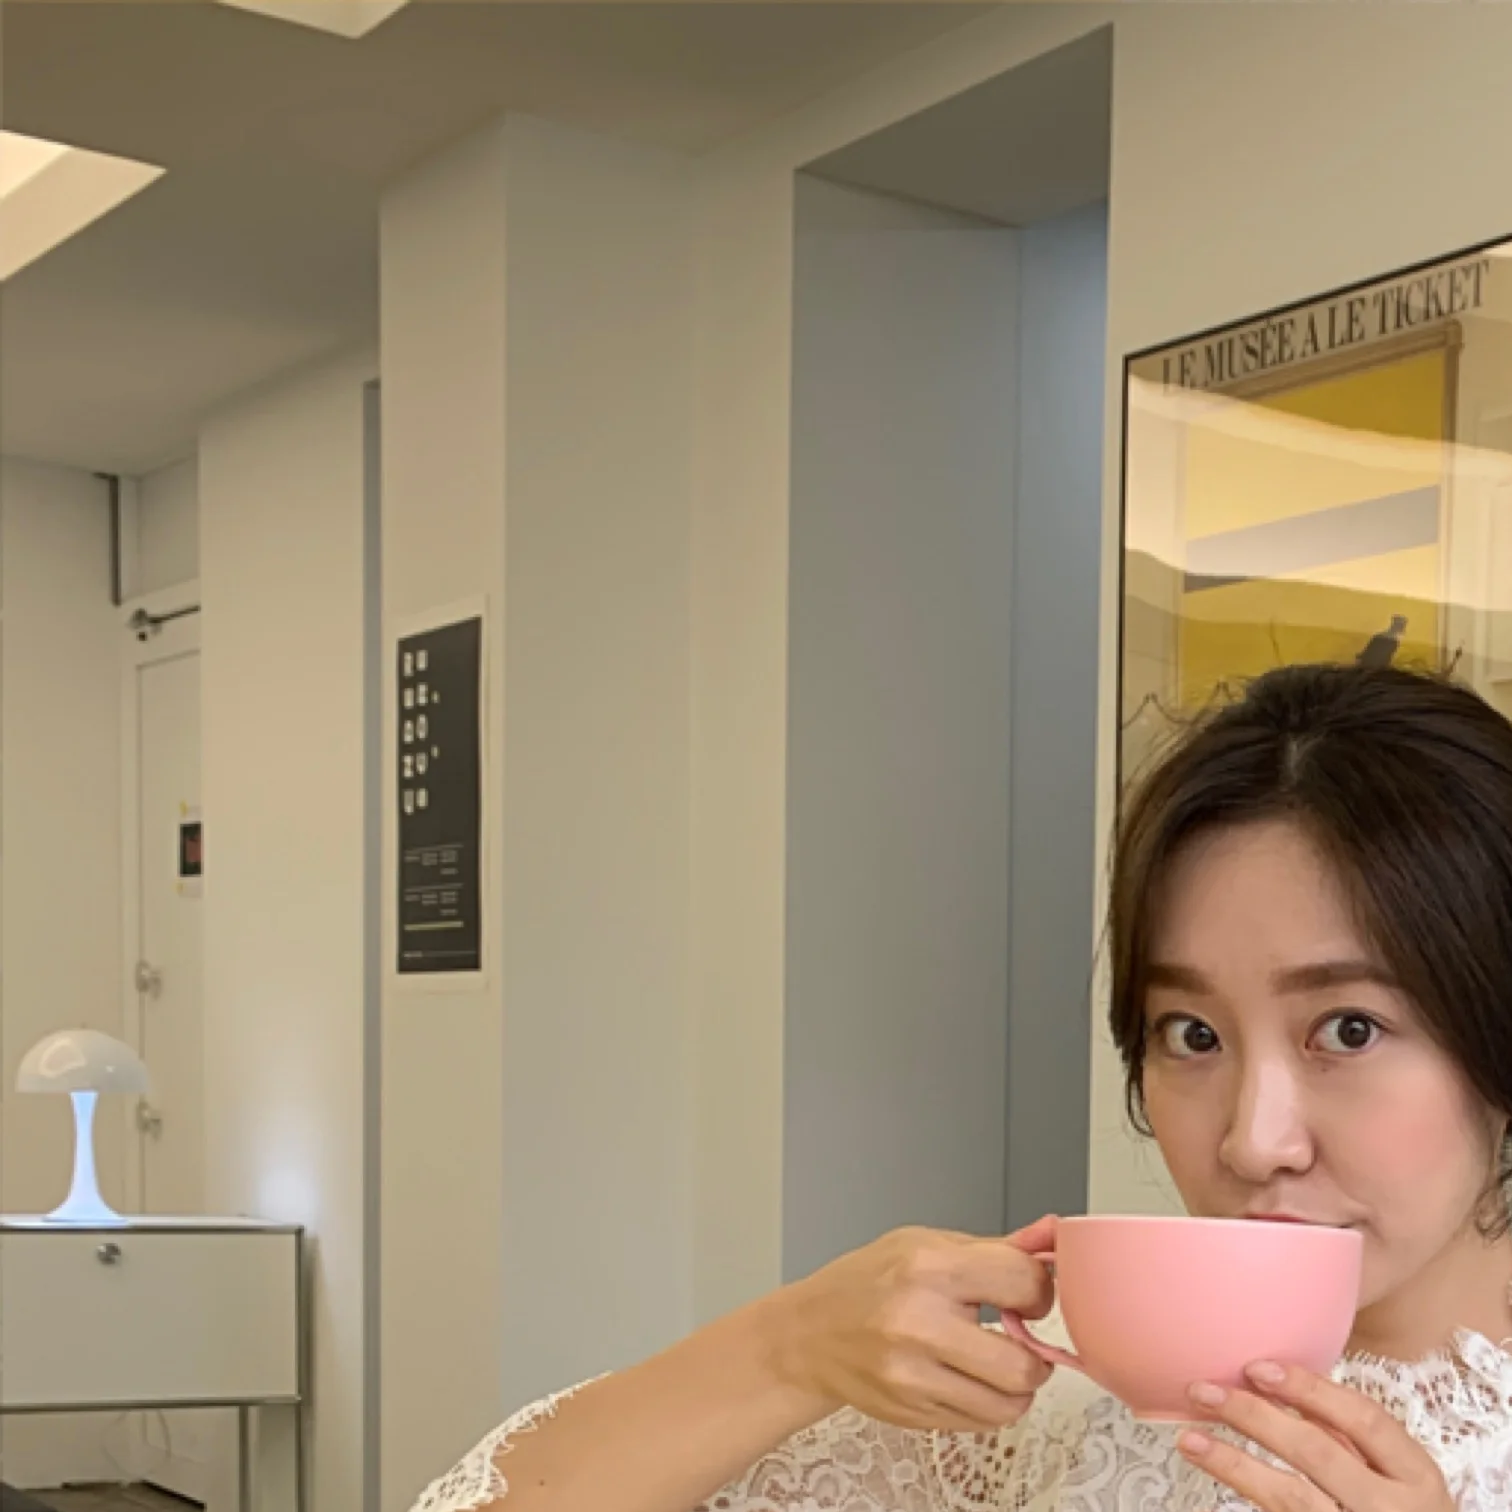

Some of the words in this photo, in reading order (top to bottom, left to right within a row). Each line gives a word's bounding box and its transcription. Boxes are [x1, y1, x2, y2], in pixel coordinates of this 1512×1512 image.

[1301, 312, 1320, 358] A
[1328, 297, 1366, 349] LE
[1373, 258, 1490, 335] TICKET
